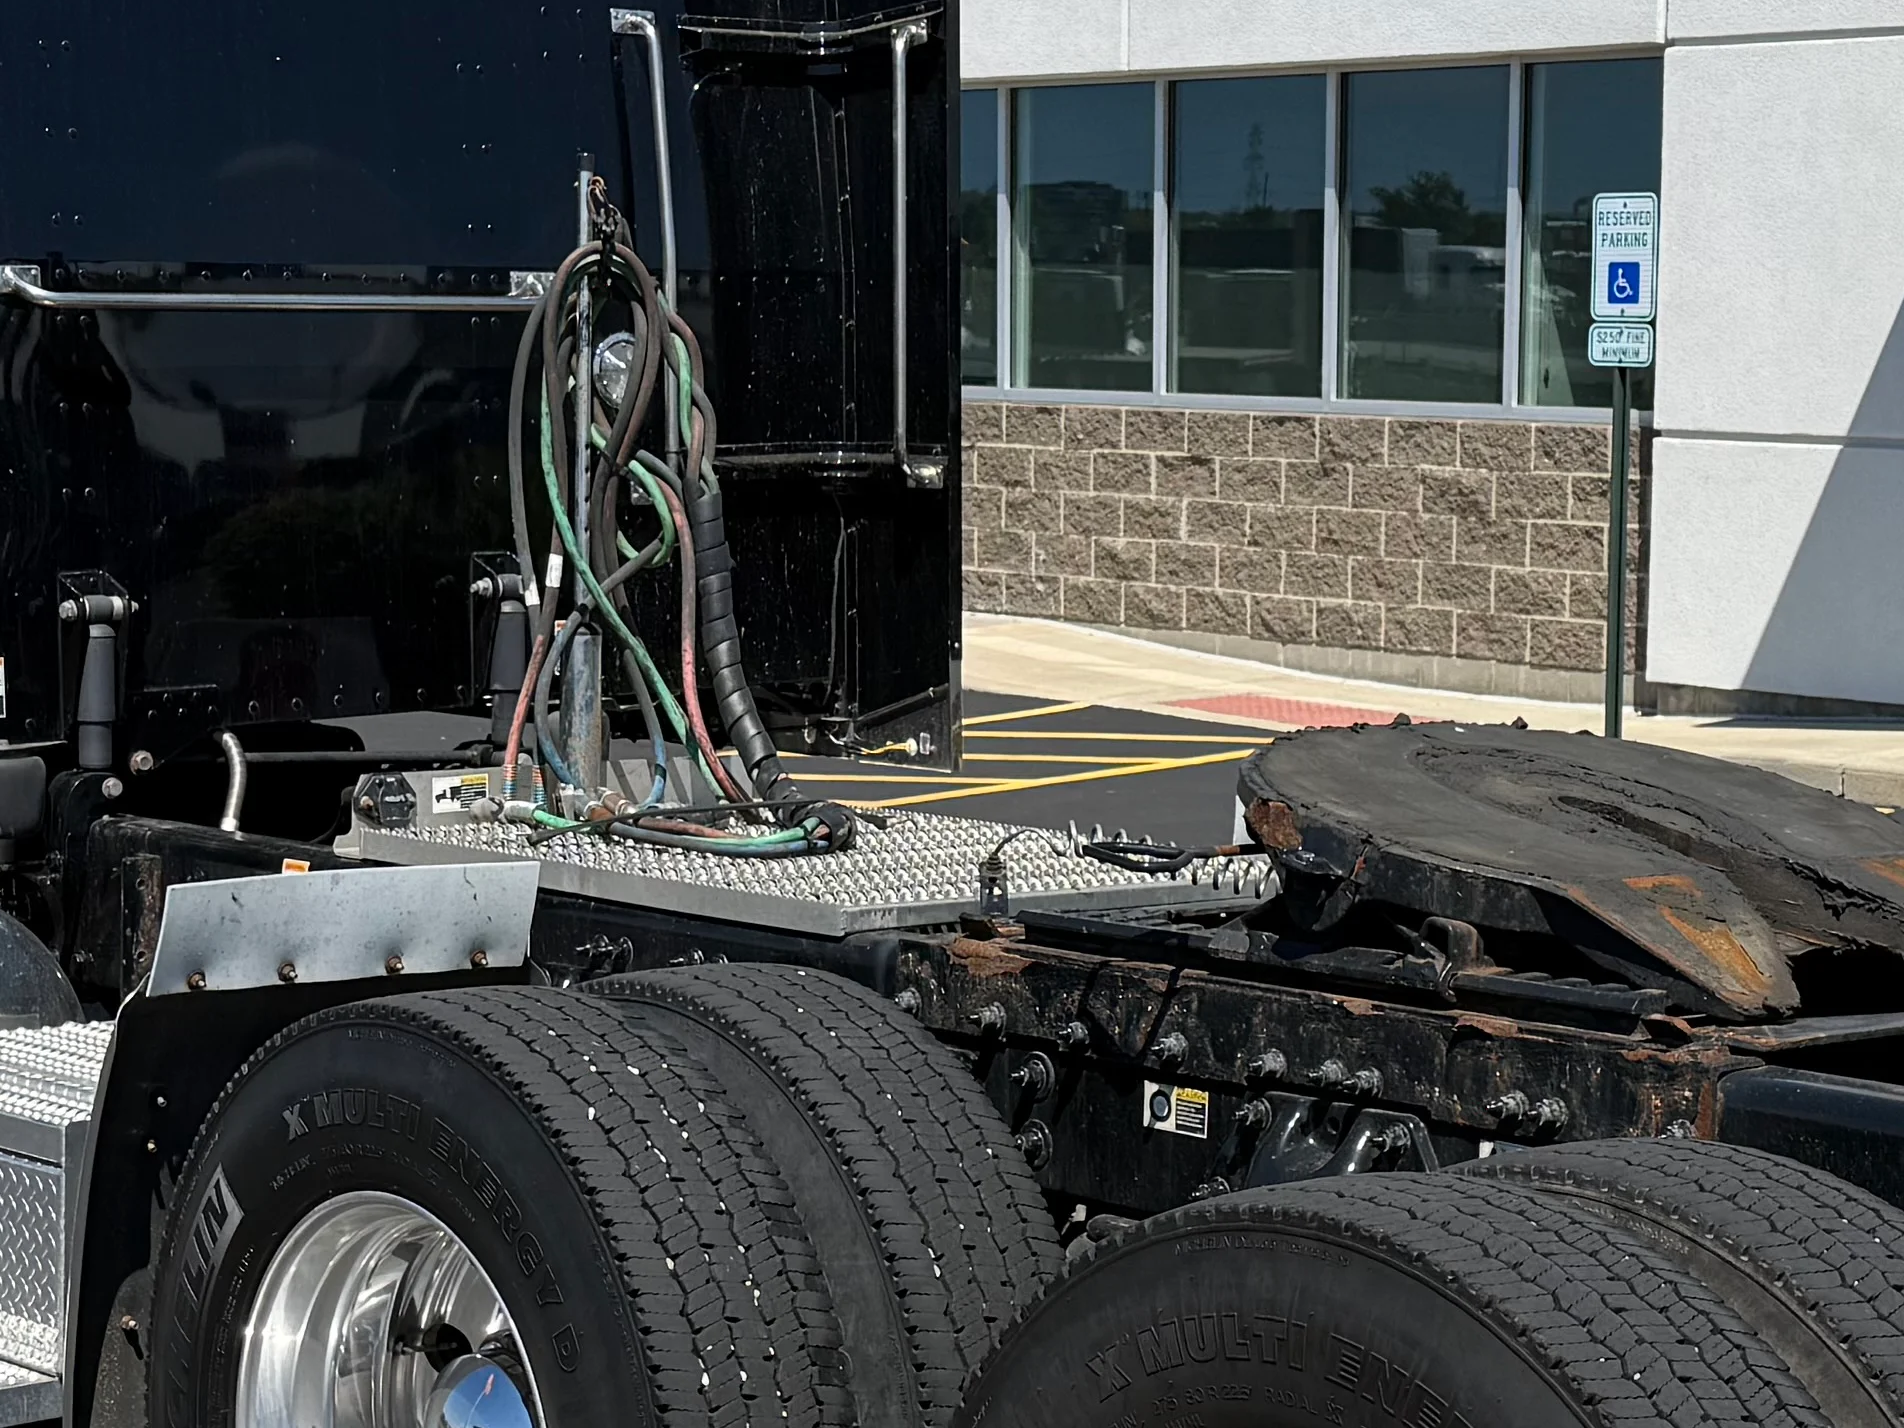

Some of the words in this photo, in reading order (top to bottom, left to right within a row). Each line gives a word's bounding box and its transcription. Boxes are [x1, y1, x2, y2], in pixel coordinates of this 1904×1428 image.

[1597, 210, 1652, 227] RESERVED
[1601, 231, 1648, 248] PARKING
[1596, 331, 1622, 344] $250
[1626, 331, 1646, 344] FINE
[1601, 346, 1640, 359] MINIMUM
[312, 1087, 424, 1143] MULTI
[427, 1116, 566, 1308] ENERGY
[1136, 1311, 1309, 1376] MULTI
